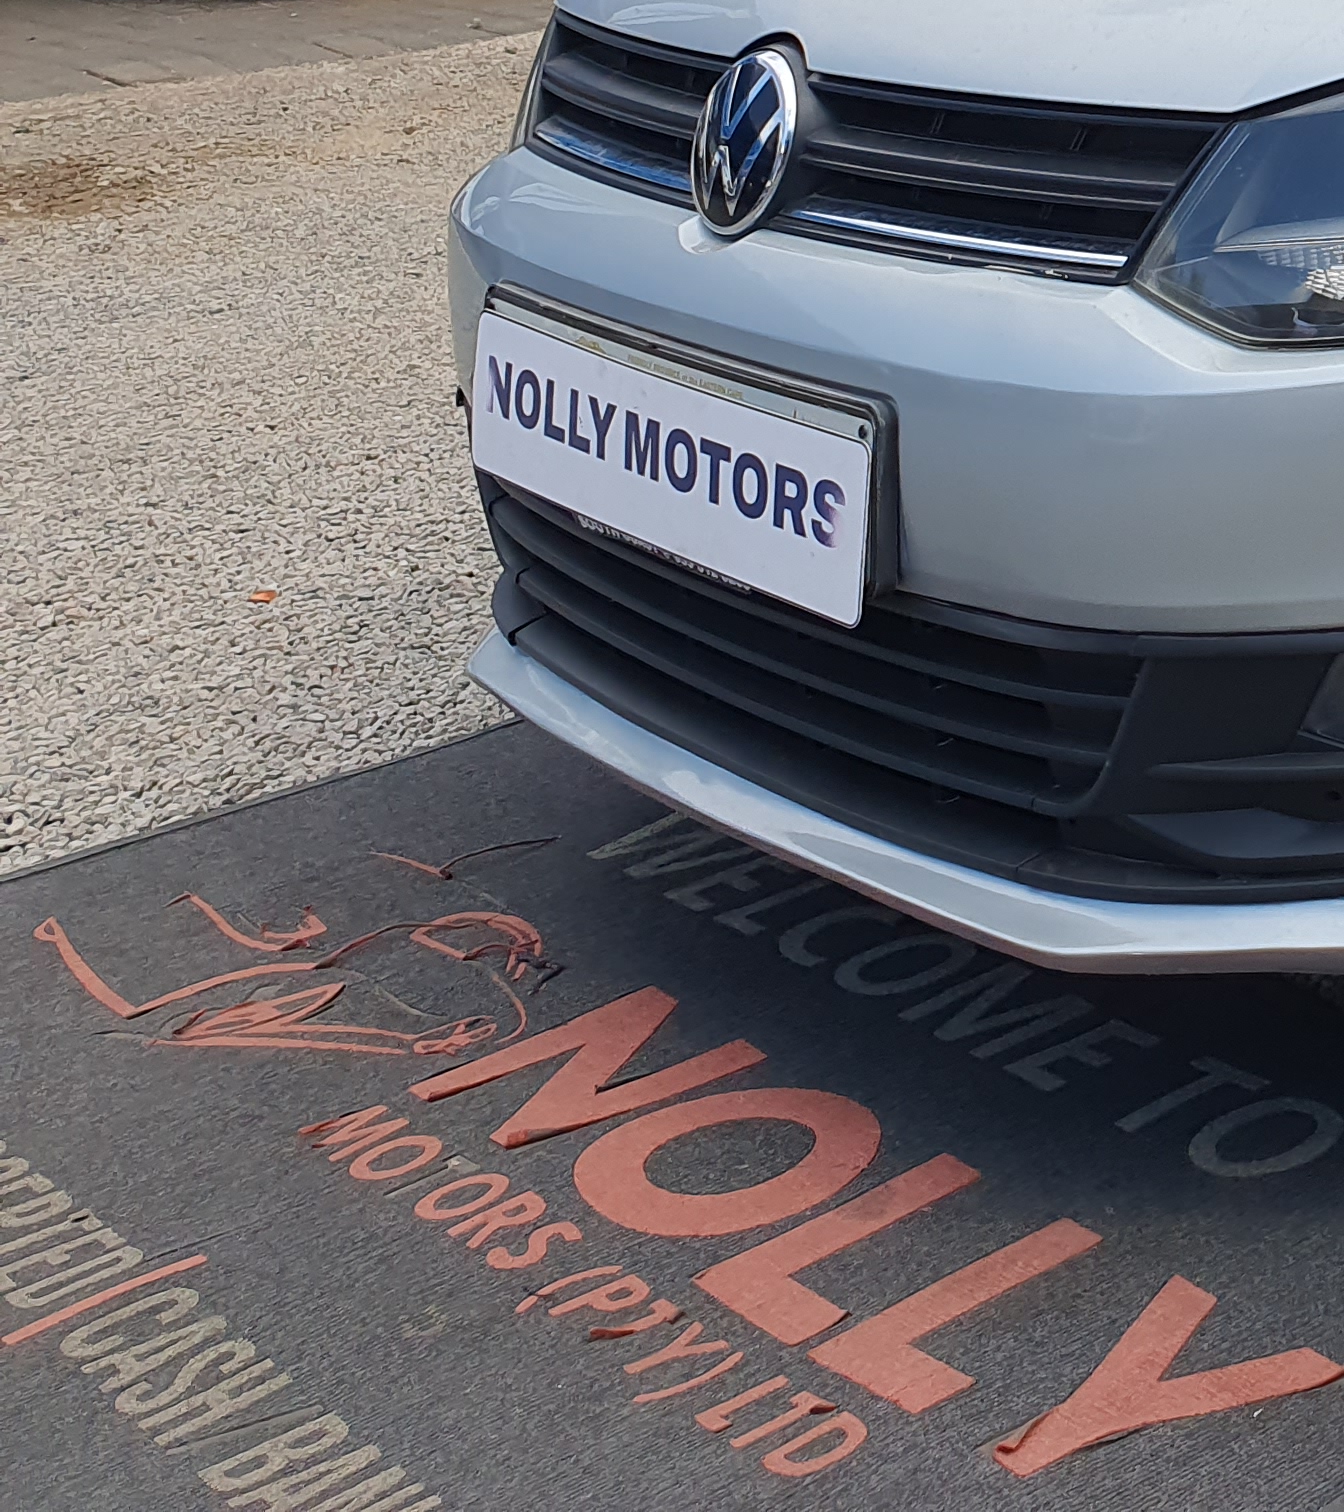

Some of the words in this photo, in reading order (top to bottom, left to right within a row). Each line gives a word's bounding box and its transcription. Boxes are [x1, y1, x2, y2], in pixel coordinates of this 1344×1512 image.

[487, 355, 617, 462] NOLLY
[624, 409, 846, 549] MOTORS
[586, 809, 1162, 1092] WELCOME
[1113, 1052, 1344, 1179] TO
[695, 1374, 869, 1477] LTD
